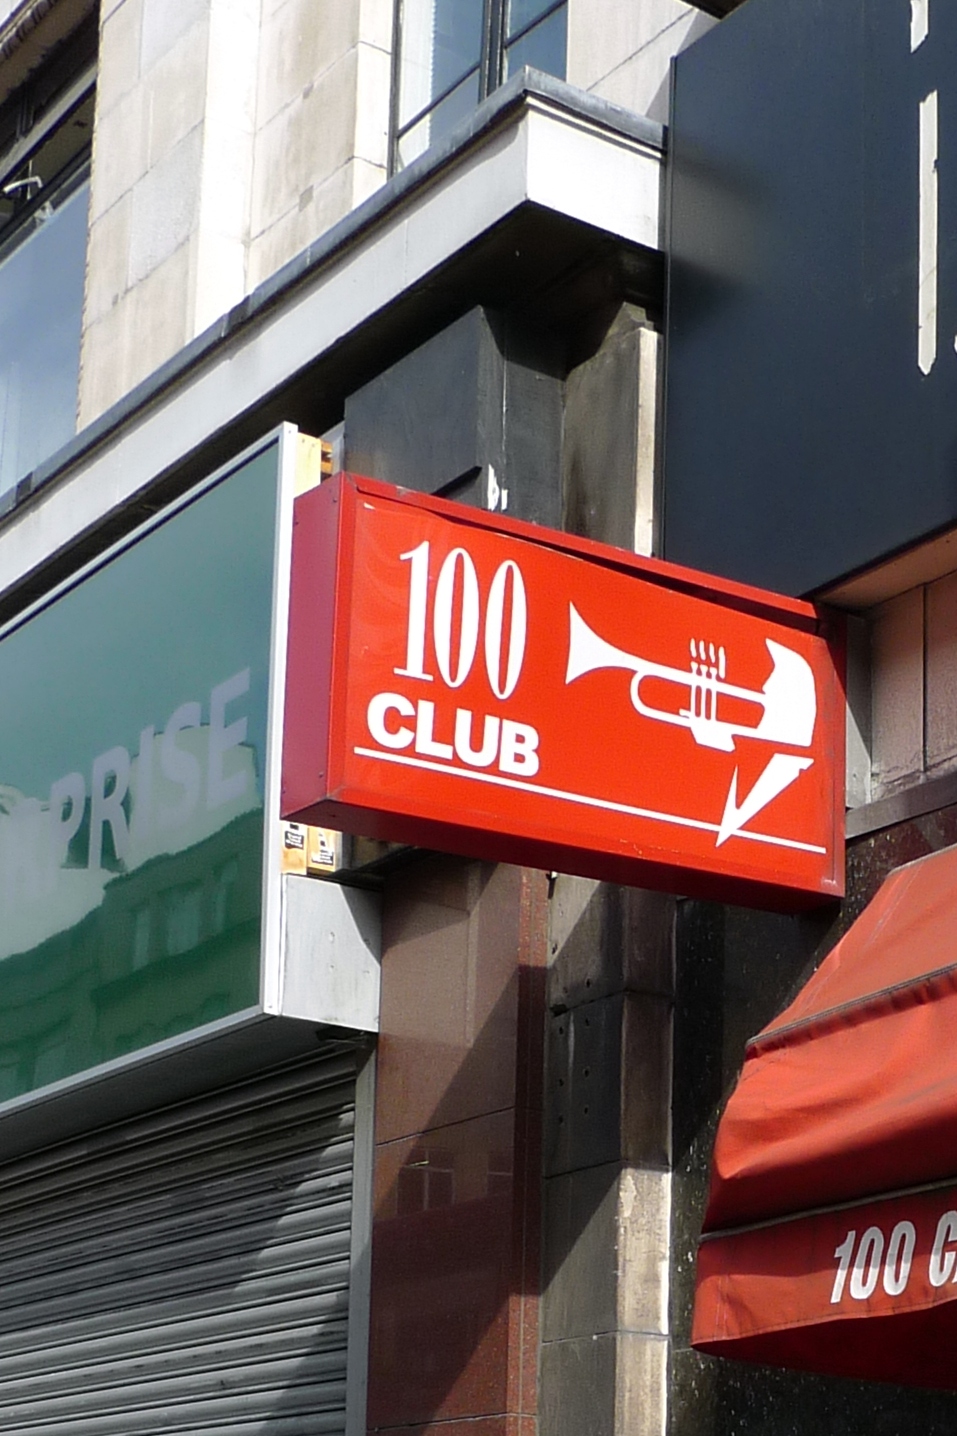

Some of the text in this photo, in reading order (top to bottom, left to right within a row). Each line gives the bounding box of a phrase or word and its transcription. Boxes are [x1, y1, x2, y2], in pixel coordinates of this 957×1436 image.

[394, 541, 527, 700] 100
[367, 692, 539, 777] CLUB
[831, 1220, 916, 1304] 100
